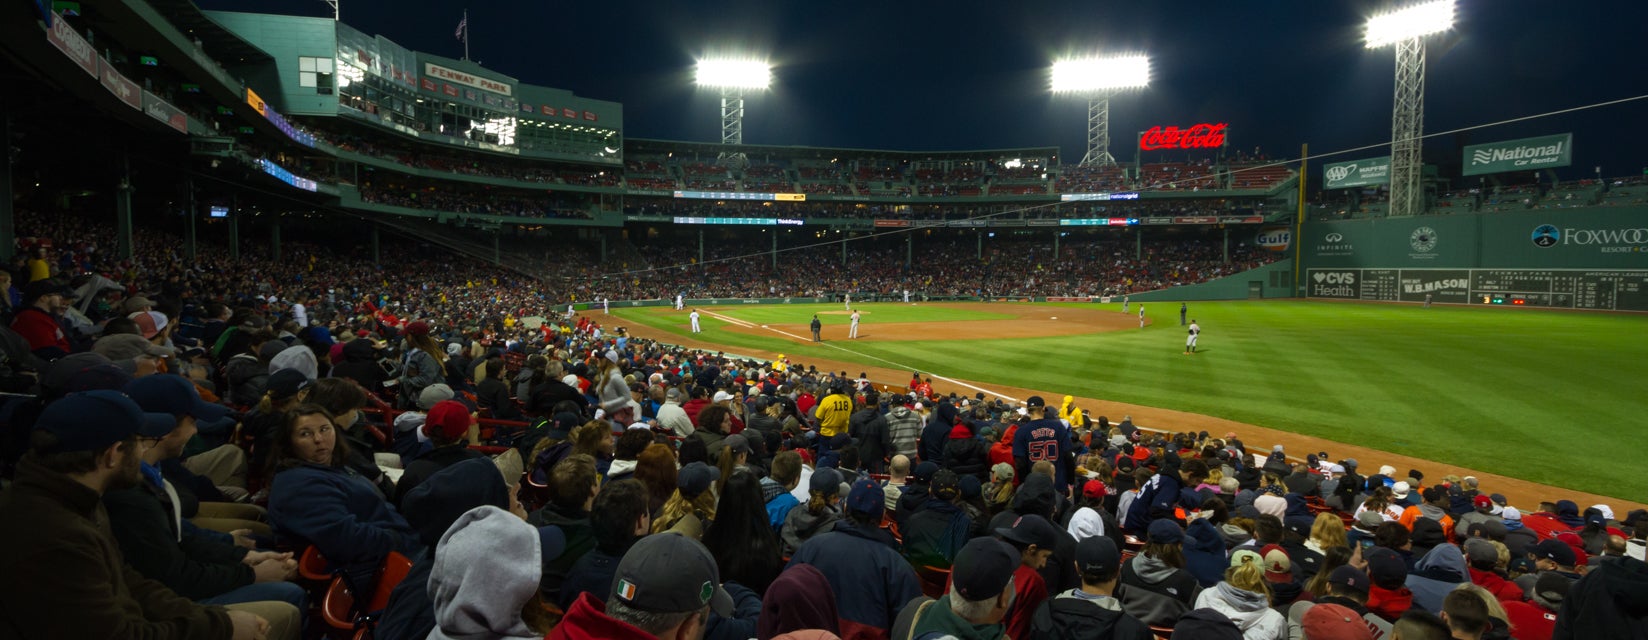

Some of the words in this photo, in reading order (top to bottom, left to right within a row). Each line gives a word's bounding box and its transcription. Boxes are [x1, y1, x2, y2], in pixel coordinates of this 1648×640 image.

[431, 66, 475, 84] FENWAY
[481, 79, 508, 94] PARK
[1140, 122, 1228, 151] Coca-Cola
[1491, 141, 1563, 162] National
[1530, 156, 1559, 165] Rental
[1258, 233, 1289, 244] Gulf
[1326, 272, 1354, 285] CVS
[1314, 284, 1354, 297] Health
[833, 400, 849, 411] 118
[1028, 440, 1059, 462] 50
